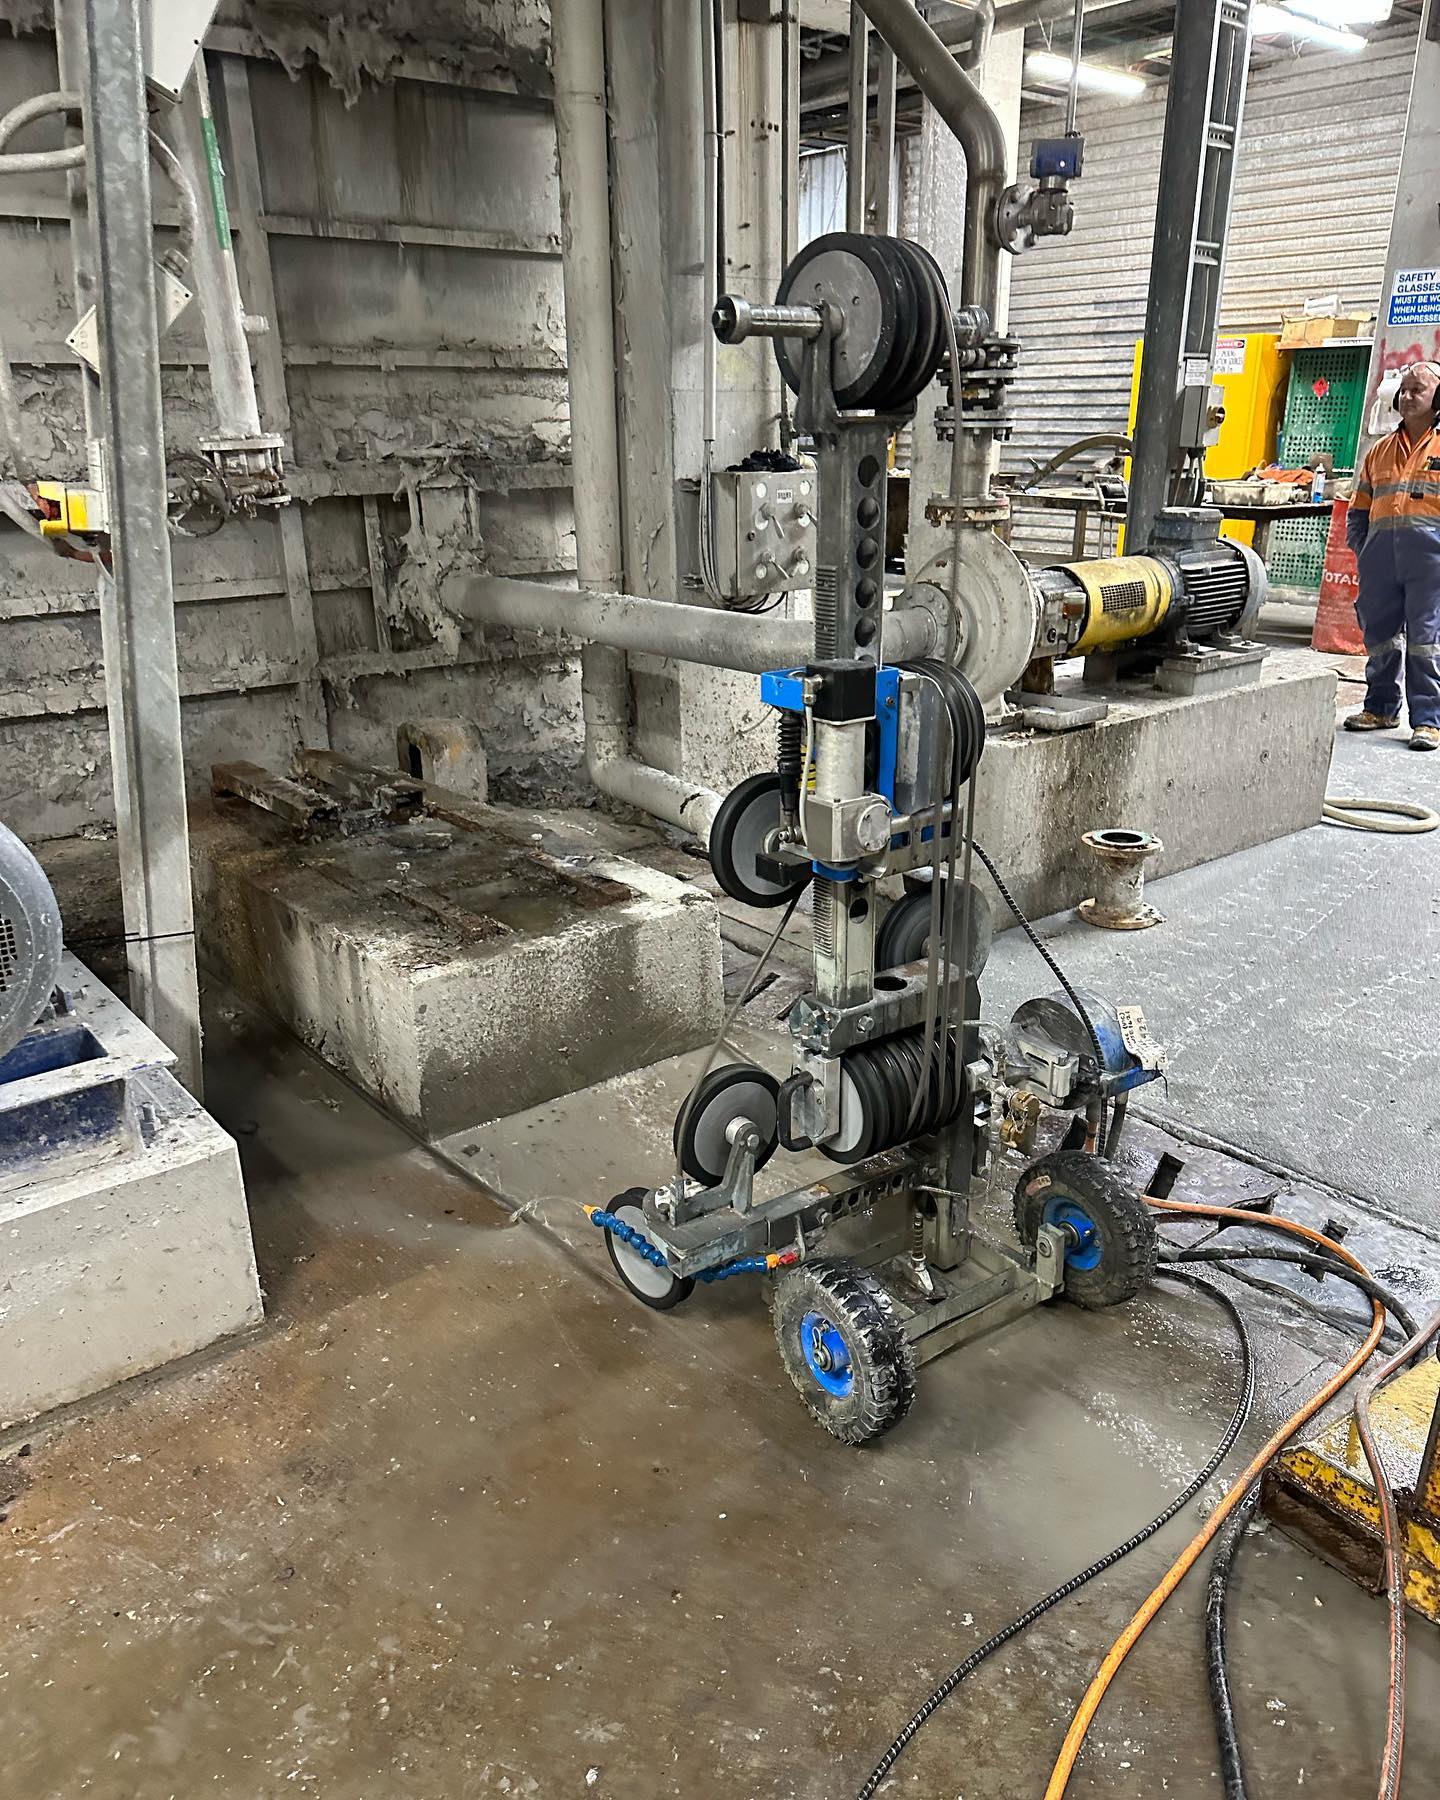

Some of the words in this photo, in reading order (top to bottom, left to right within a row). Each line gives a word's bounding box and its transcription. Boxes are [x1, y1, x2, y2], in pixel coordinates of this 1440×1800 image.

[1399, 272, 1436, 283] SAFETY
[1397, 283, 1440, 293] GLASSES
[1395, 296, 1417, 305] MUST
[1418, 295, 1429, 304] BE
[1393, 305, 1416, 314] WHEN
[1418, 304, 1440, 313] USING
[1392, 314, 1440, 323] COMPRESSE
